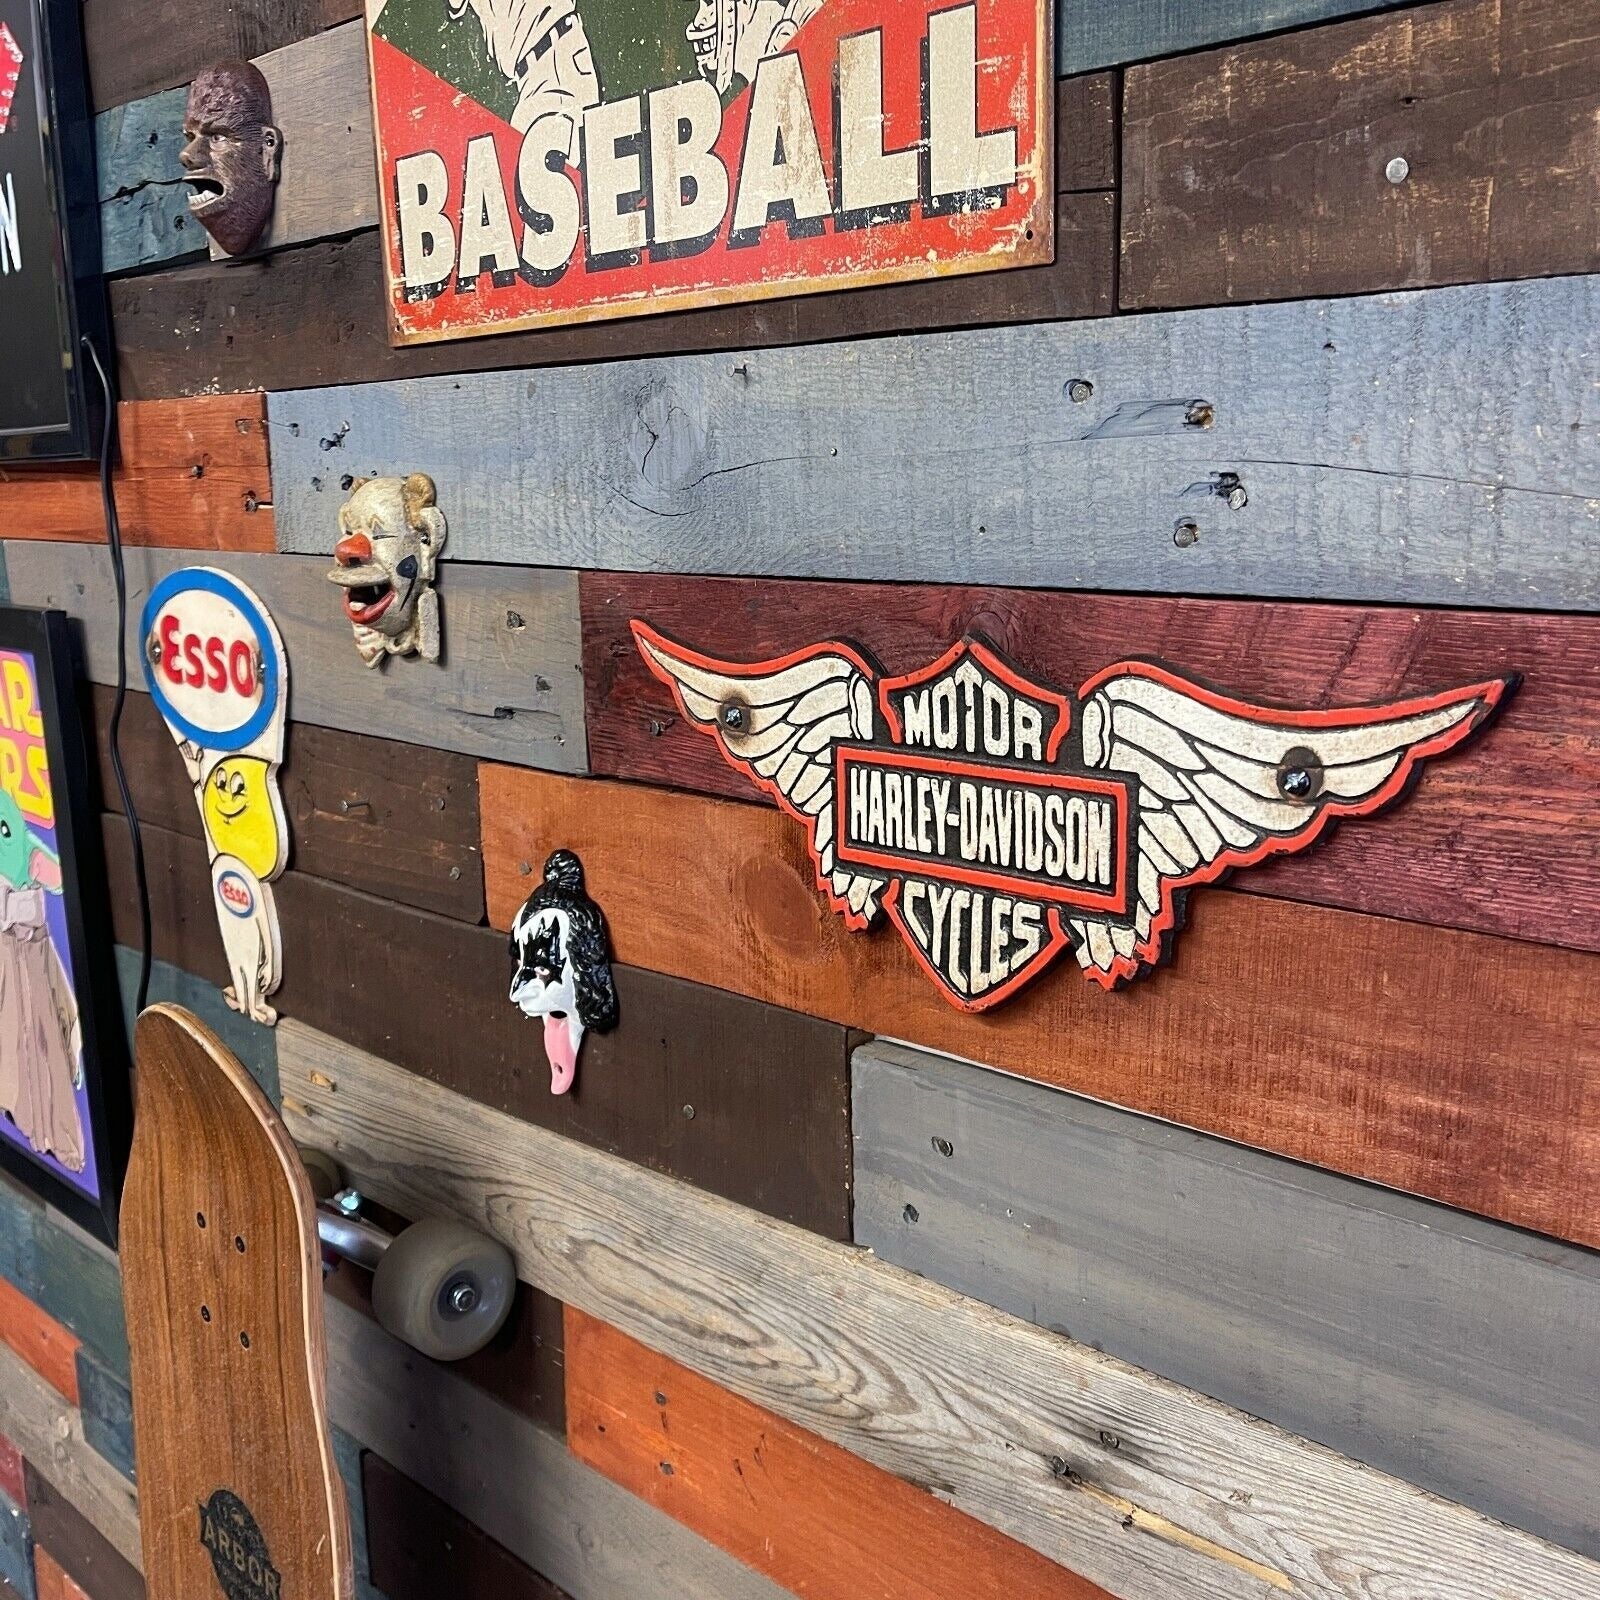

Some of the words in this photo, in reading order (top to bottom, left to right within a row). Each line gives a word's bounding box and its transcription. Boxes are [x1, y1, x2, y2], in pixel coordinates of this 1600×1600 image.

[395, 4, 1018, 295] BASEBALL
[902, 659, 1043, 761] MOTOR
[849, 766, 1112, 886] HARLEY-DAVIDSON
[902, 880, 1042, 995] CYCLES
[203, 1517, 279, 1600] ARBOR
